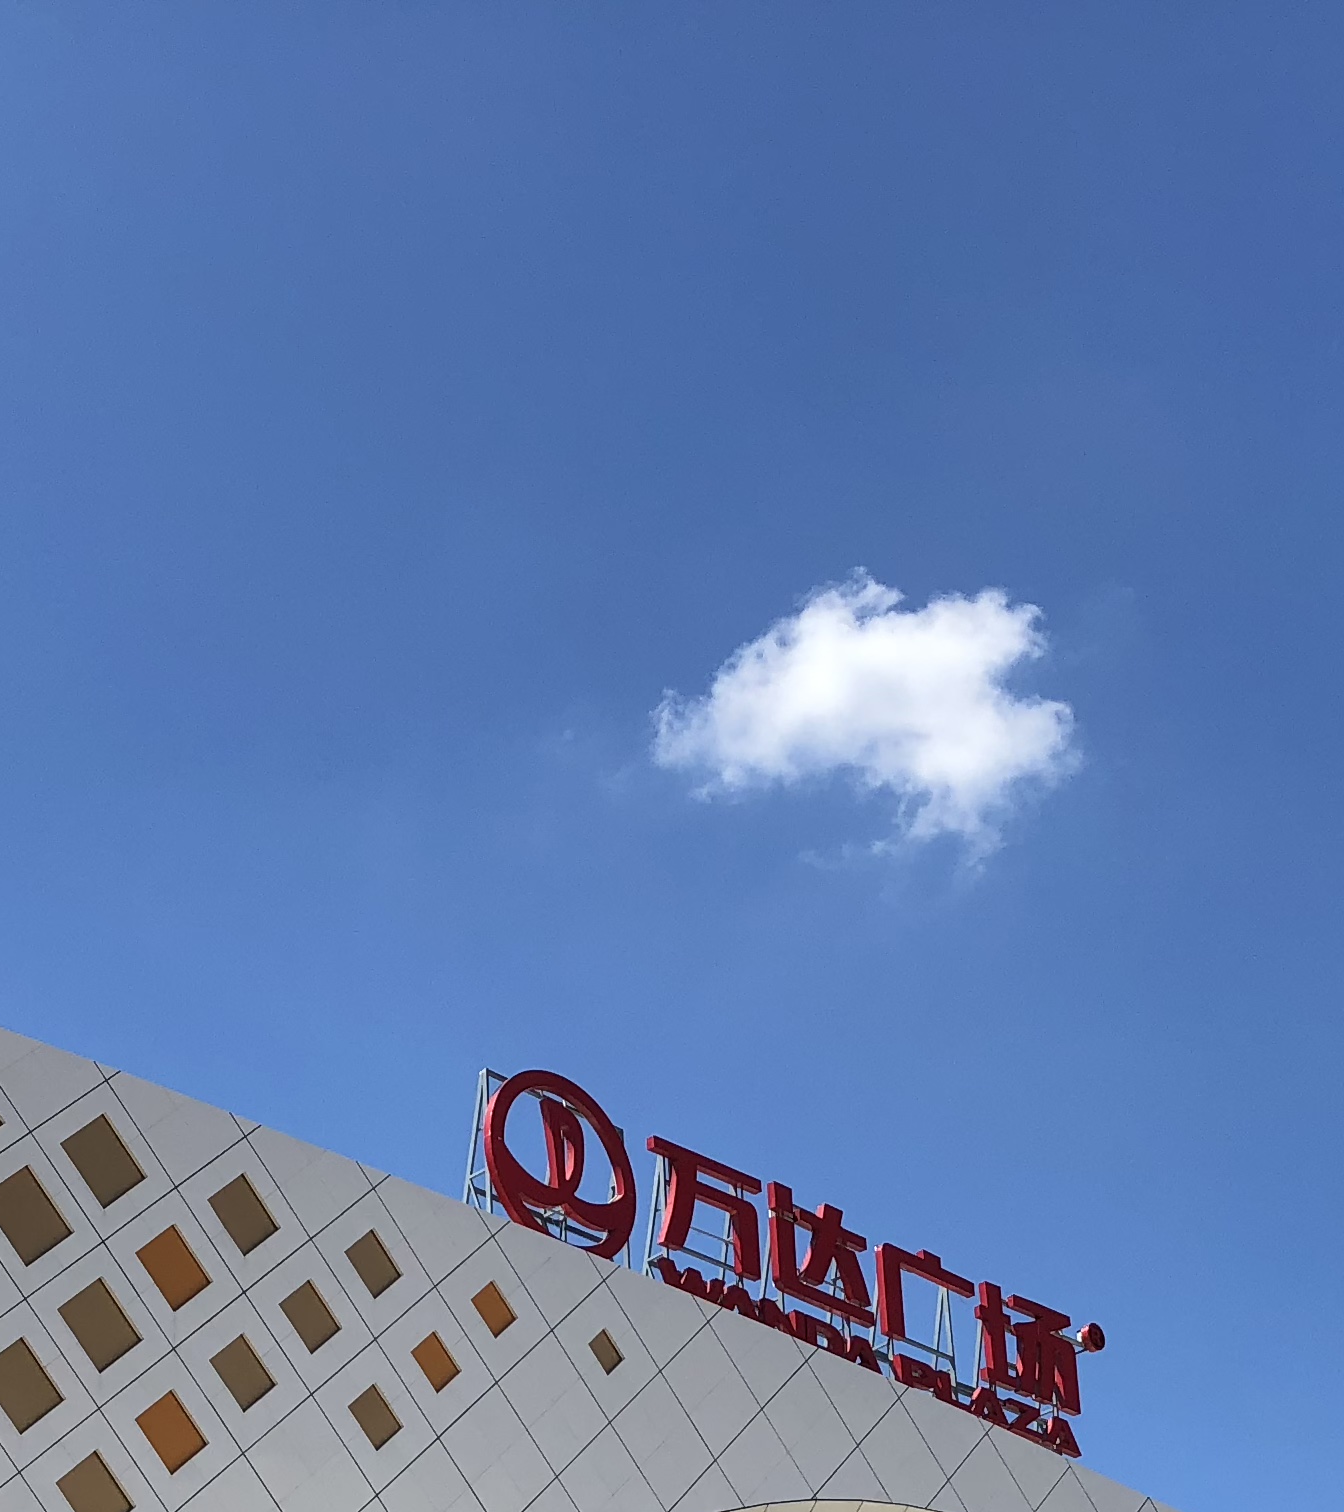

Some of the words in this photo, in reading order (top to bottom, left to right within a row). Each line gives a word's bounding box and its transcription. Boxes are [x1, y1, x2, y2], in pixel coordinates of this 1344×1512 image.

[646, 1135, 1081, 1416] 万达广场
[892, 1353, 1083, 1459] PLAZA
